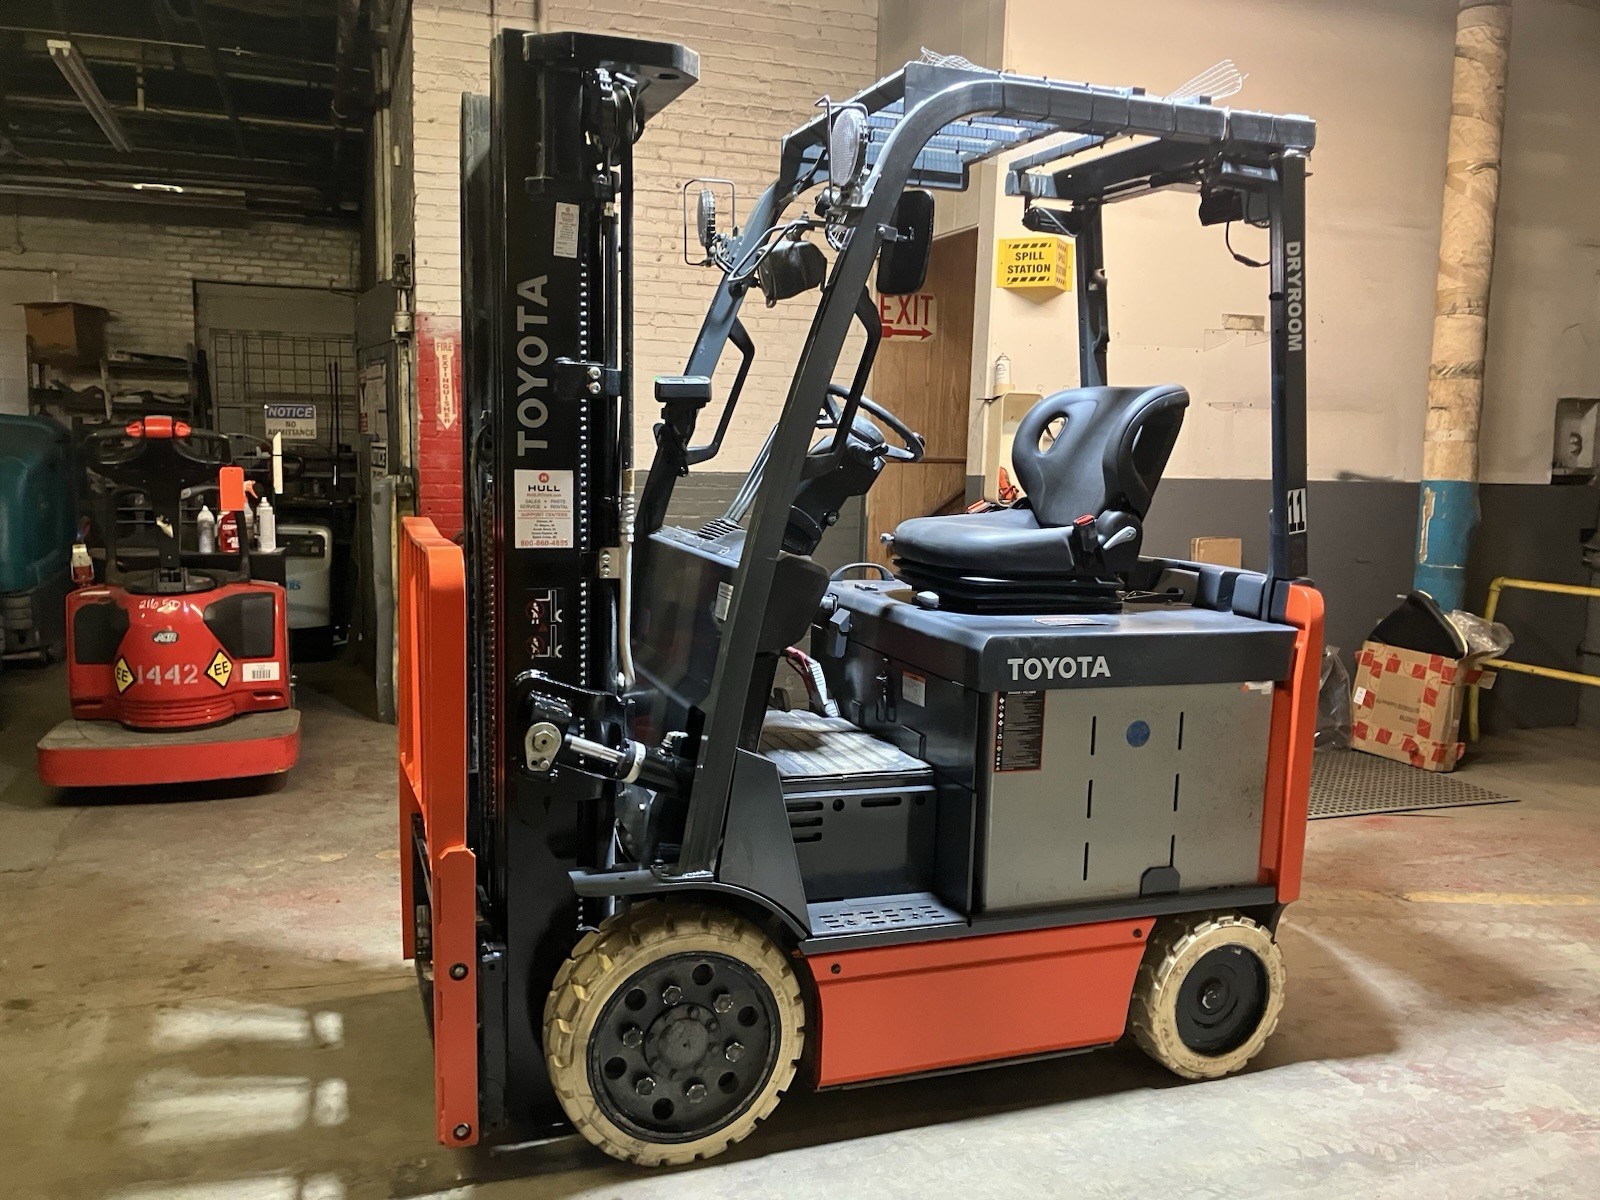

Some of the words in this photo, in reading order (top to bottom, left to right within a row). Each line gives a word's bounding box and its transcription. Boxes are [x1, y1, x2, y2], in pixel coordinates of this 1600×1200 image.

[1015, 251, 1045, 261] SPILL
[1007, 263, 1050, 275] STATION
[1286, 241, 1303, 352] DRYROOM
[880, 294, 933, 325] EXIT
[436, 342, 453, 352] FIRE
[516, 274, 549, 457] TOYOTA
[442, 354, 451, 424] EXTINGUISHER
[268, 406, 314, 418] NOTICE
[285, 420, 297, 428] NO
[1288, 490, 1305, 533] 11
[116, 668, 129, 683] EE
[136, 663, 199, 686] 1442
[213, 660, 230, 677] EE
[1007, 655, 1111, 681] TOYOTA
